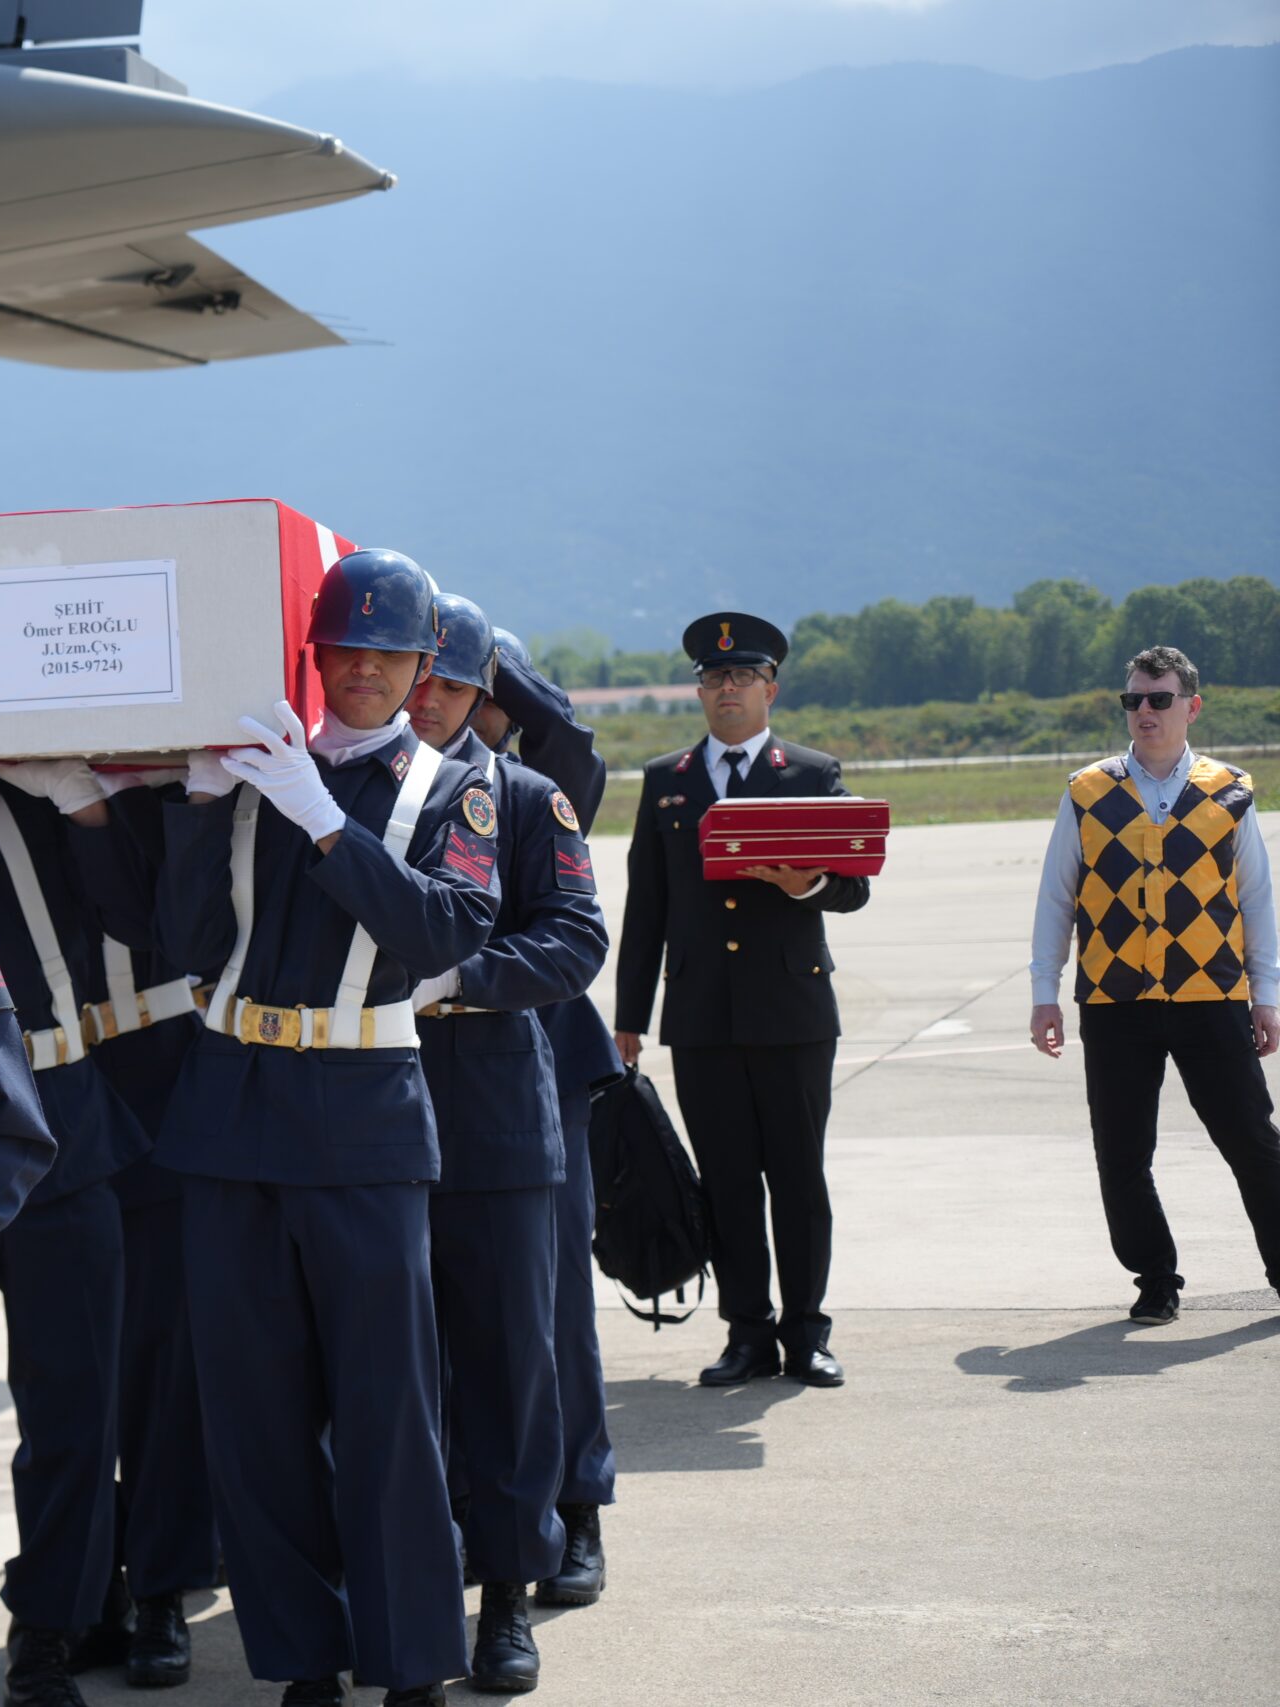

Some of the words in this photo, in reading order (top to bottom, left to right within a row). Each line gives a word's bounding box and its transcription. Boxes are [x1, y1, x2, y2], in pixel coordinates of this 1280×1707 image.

[54, 599, 104, 619] ŞEHİT
[23, 622, 63, 638] Ömer
[68, 617, 138, 635] EROĞLU
[41, 640, 121, 656] J.Uzm.Çvş.
[41, 658, 123, 677] (2015-9724)
